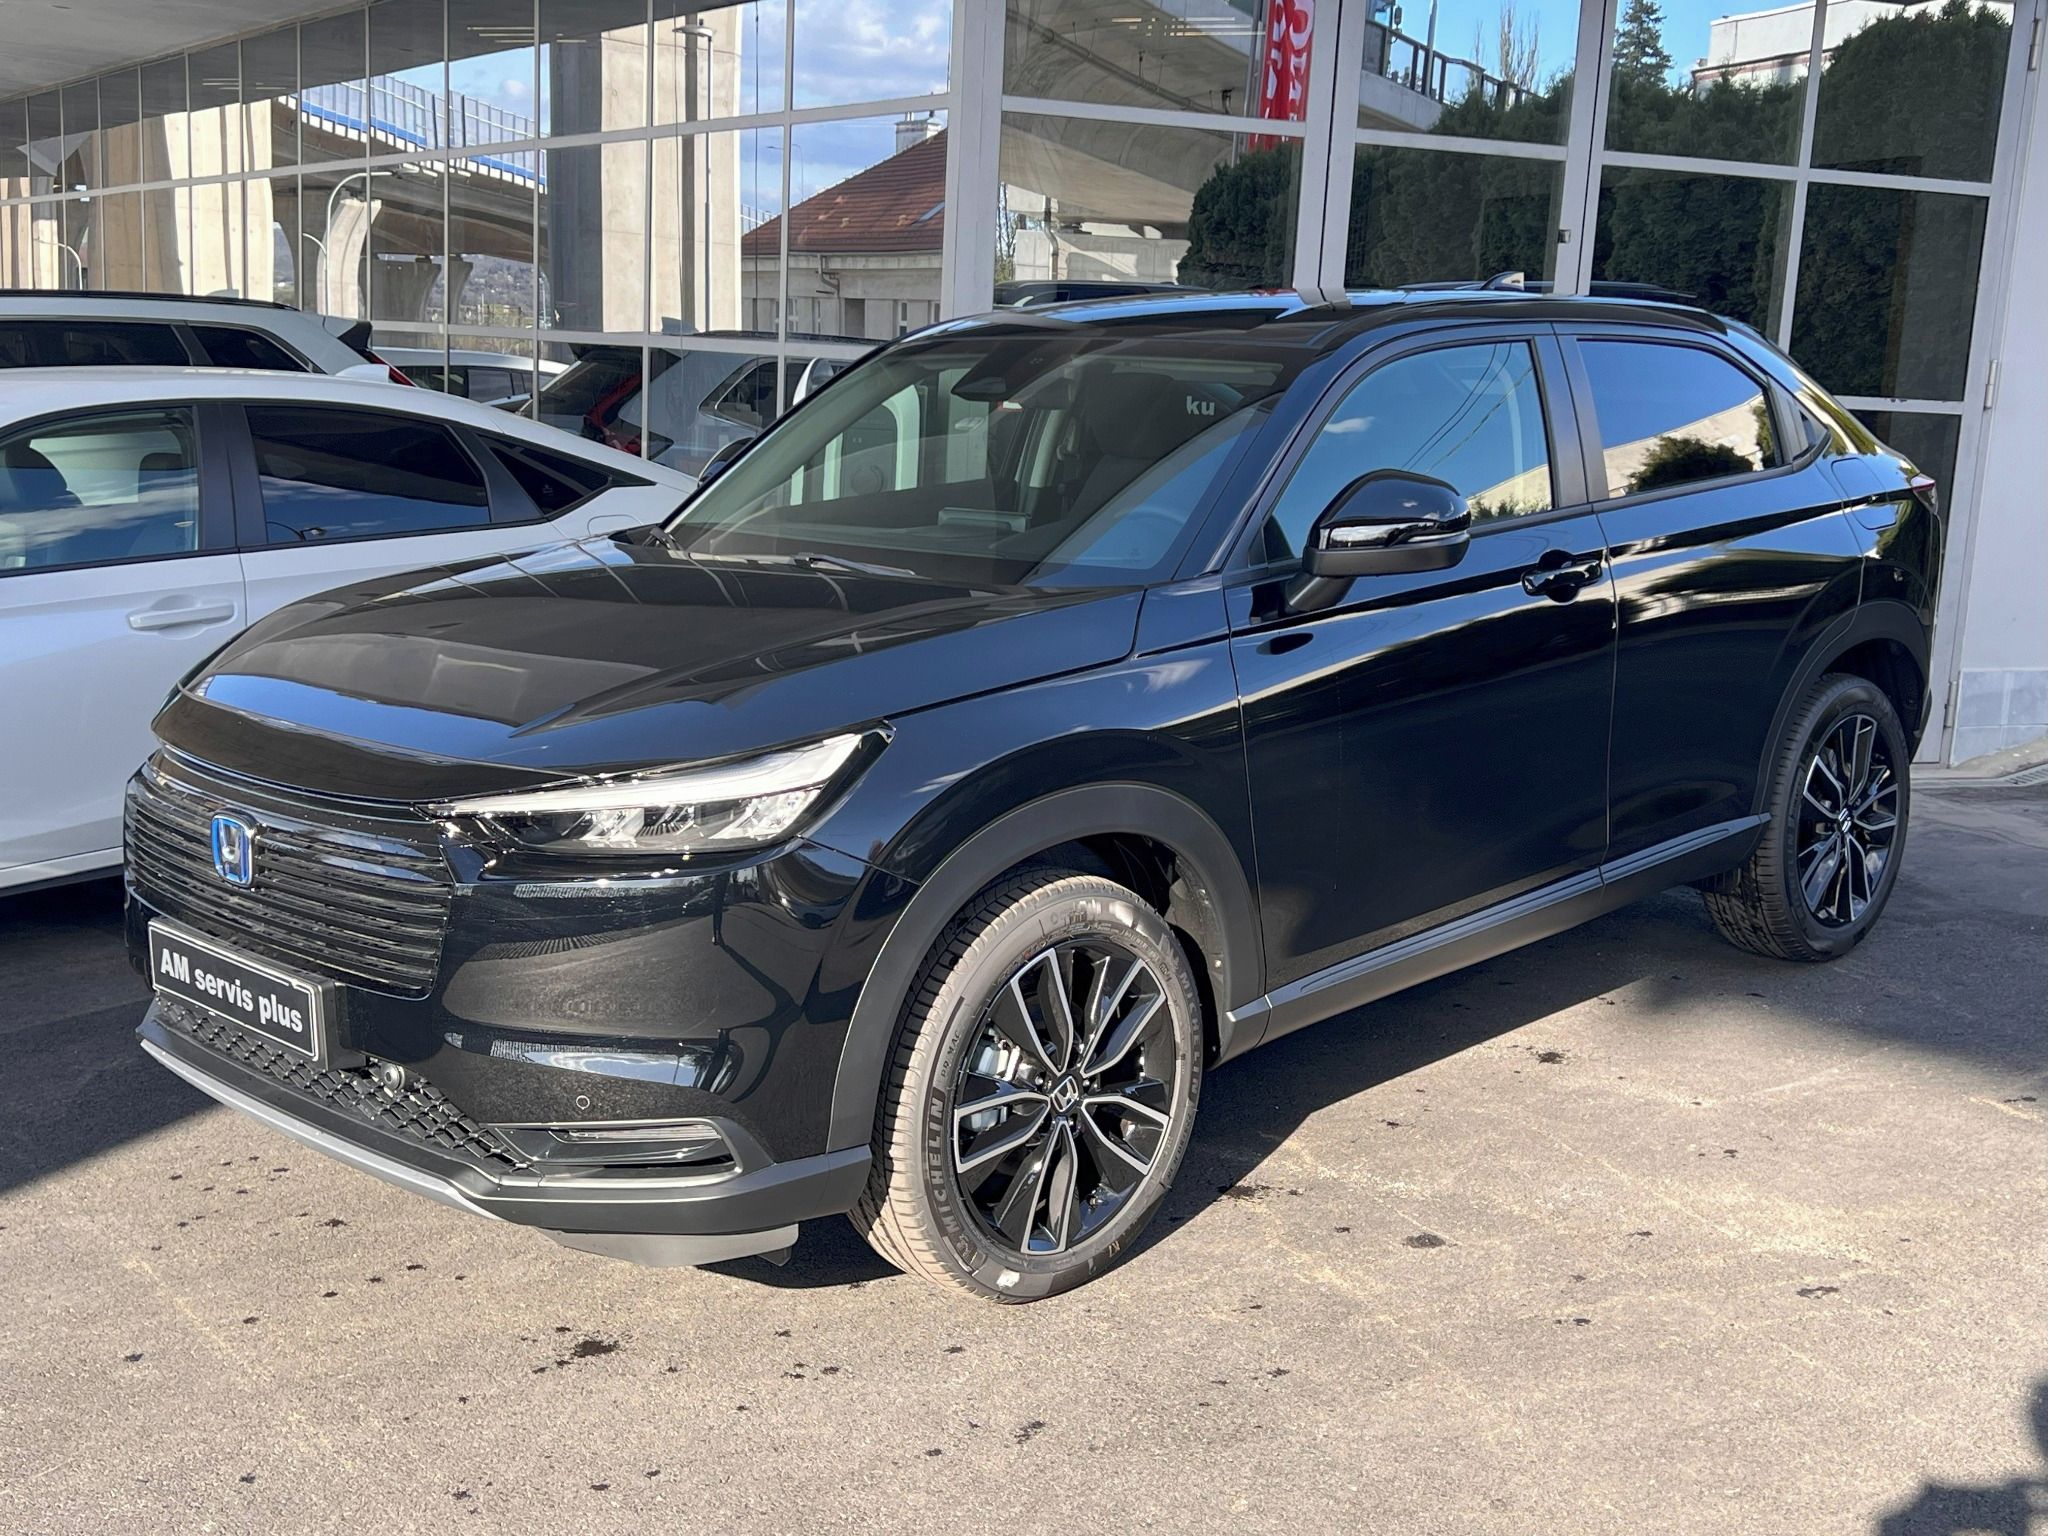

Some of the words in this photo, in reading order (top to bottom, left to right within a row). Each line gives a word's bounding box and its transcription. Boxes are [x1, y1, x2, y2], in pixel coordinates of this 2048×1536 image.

[1186, 396, 1215, 416] ku
[160, 948, 190, 984] AM
[194, 968, 254, 1012] servis
[259, 994, 303, 1033] plus
[1180, 970, 1201, 1095] MICHELIN
[928, 1098, 960, 1238] MICHELIN
